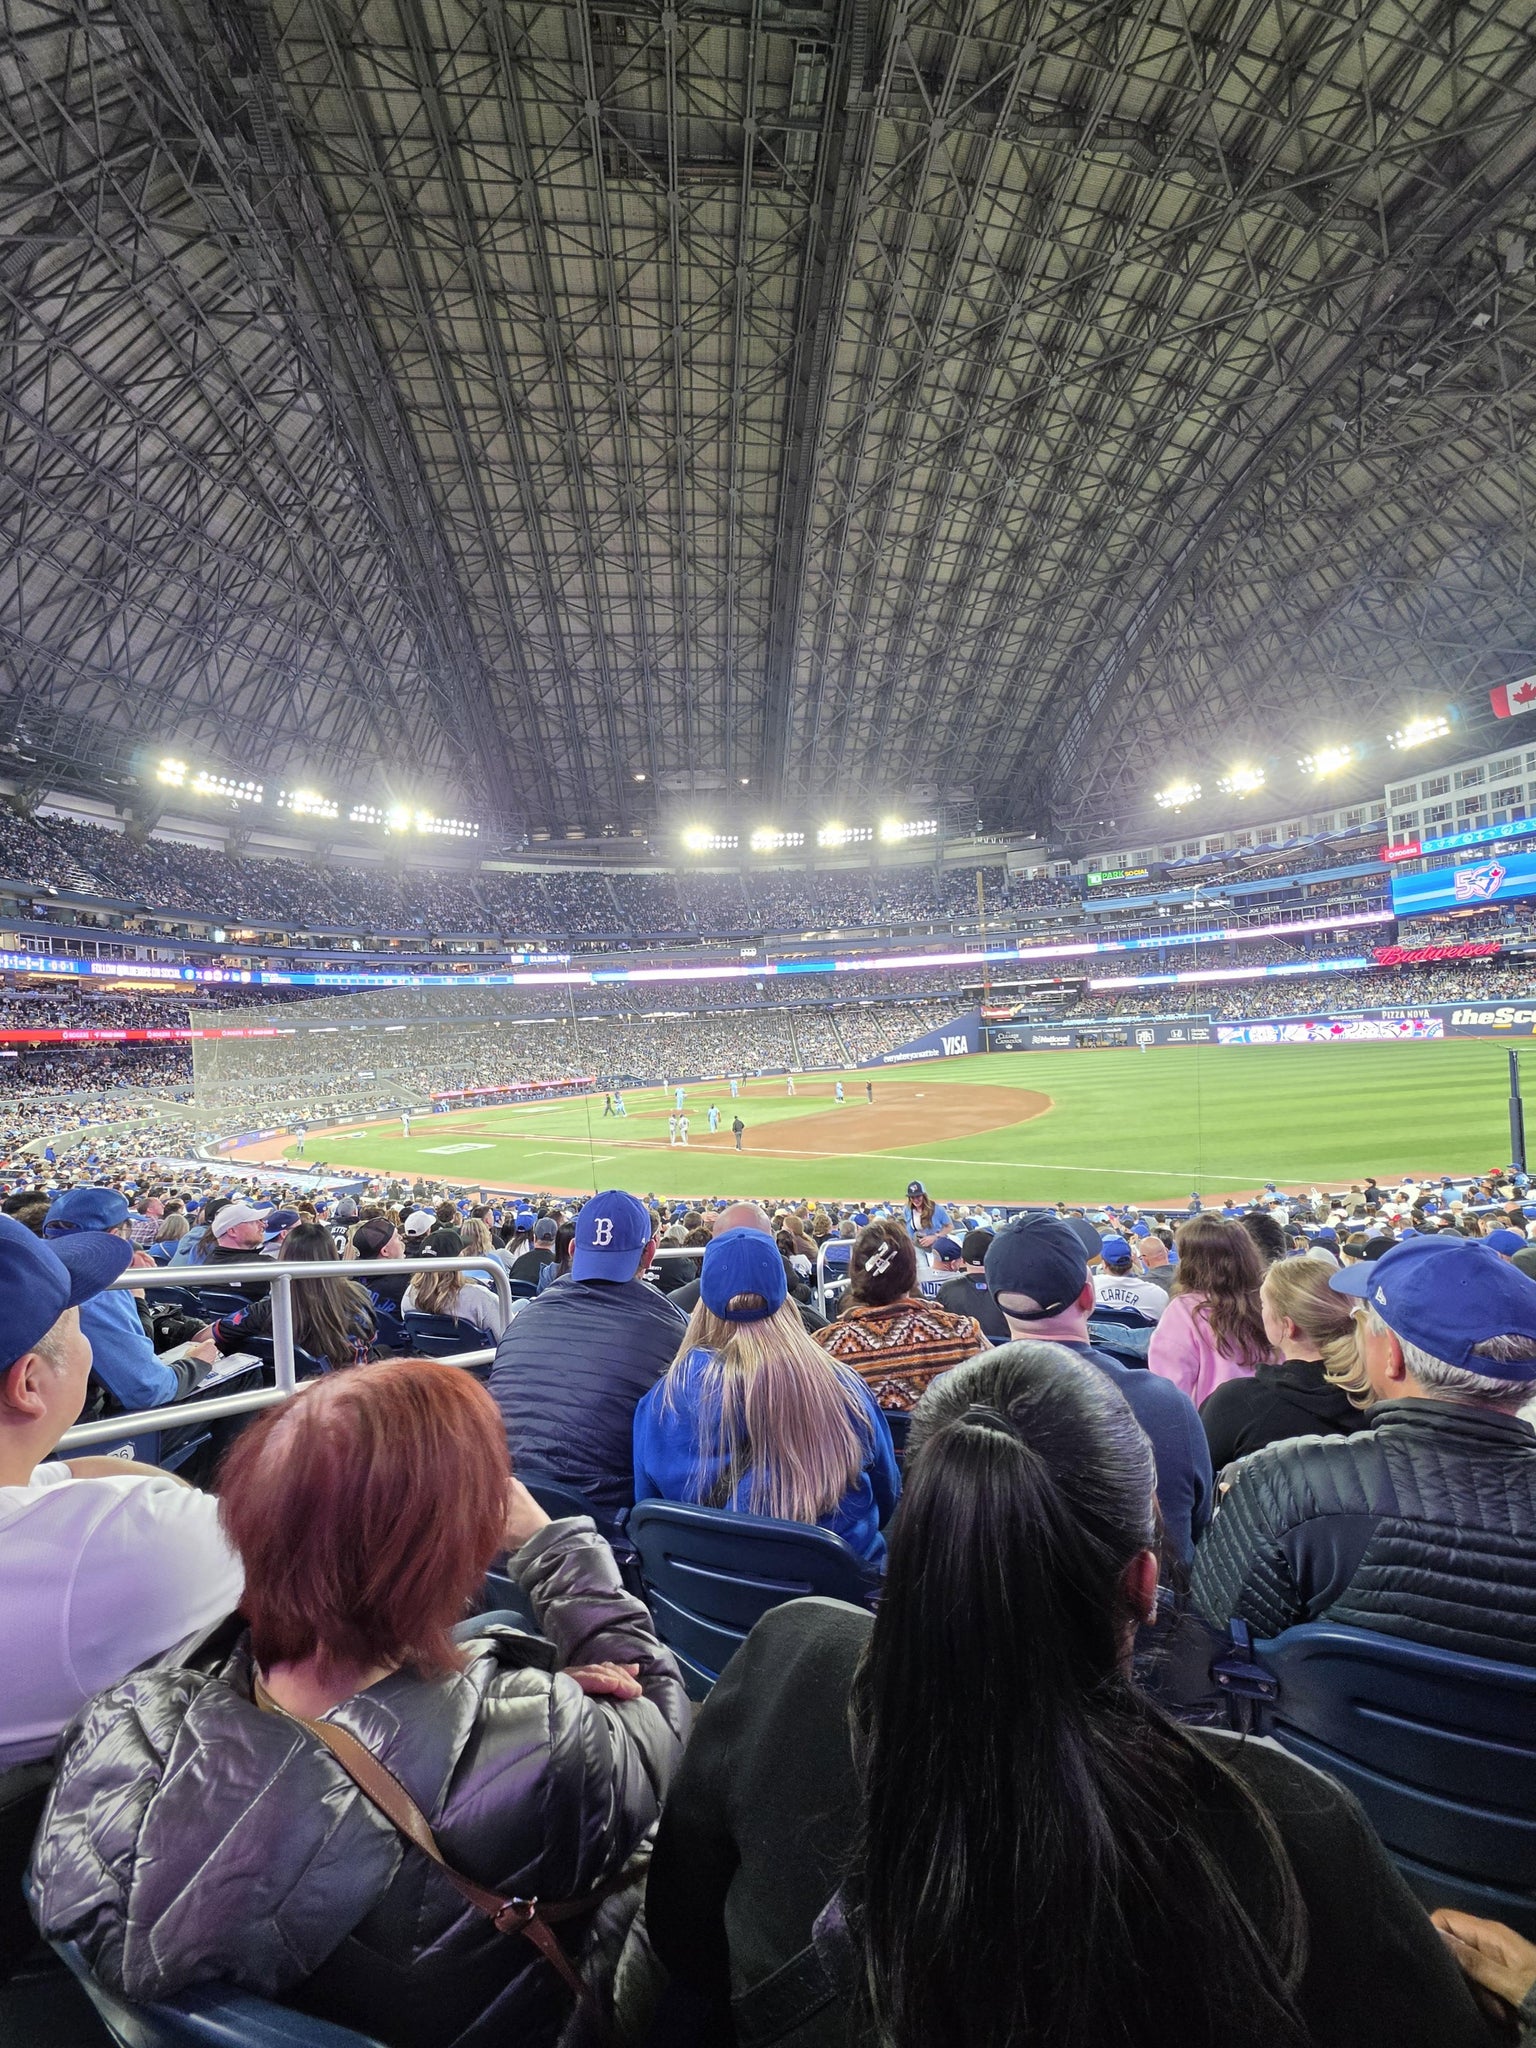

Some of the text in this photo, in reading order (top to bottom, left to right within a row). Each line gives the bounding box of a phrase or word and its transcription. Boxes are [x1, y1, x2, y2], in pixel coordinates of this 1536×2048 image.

[1394, 847, 1417, 857] ROGERS
[1102, 870, 1125, 881] PARK
[1124, 868, 1149, 877] SOCIAL
[1327, 896, 1348, 904] GEORGE
[1374, 942, 1500, 965] Budweiser
[91, 963, 117, 974] FOLLOW
[1381, 1009, 1430, 1019] PIZZA NOVA
[1040, 1035, 1070, 1043] National
[941, 1036, 969, 1056] VISA
[330, 1226, 348, 1235] ETTS
[592, 1217, 614, 1246] B
[1100, 1288, 1140, 1306] CARTER
